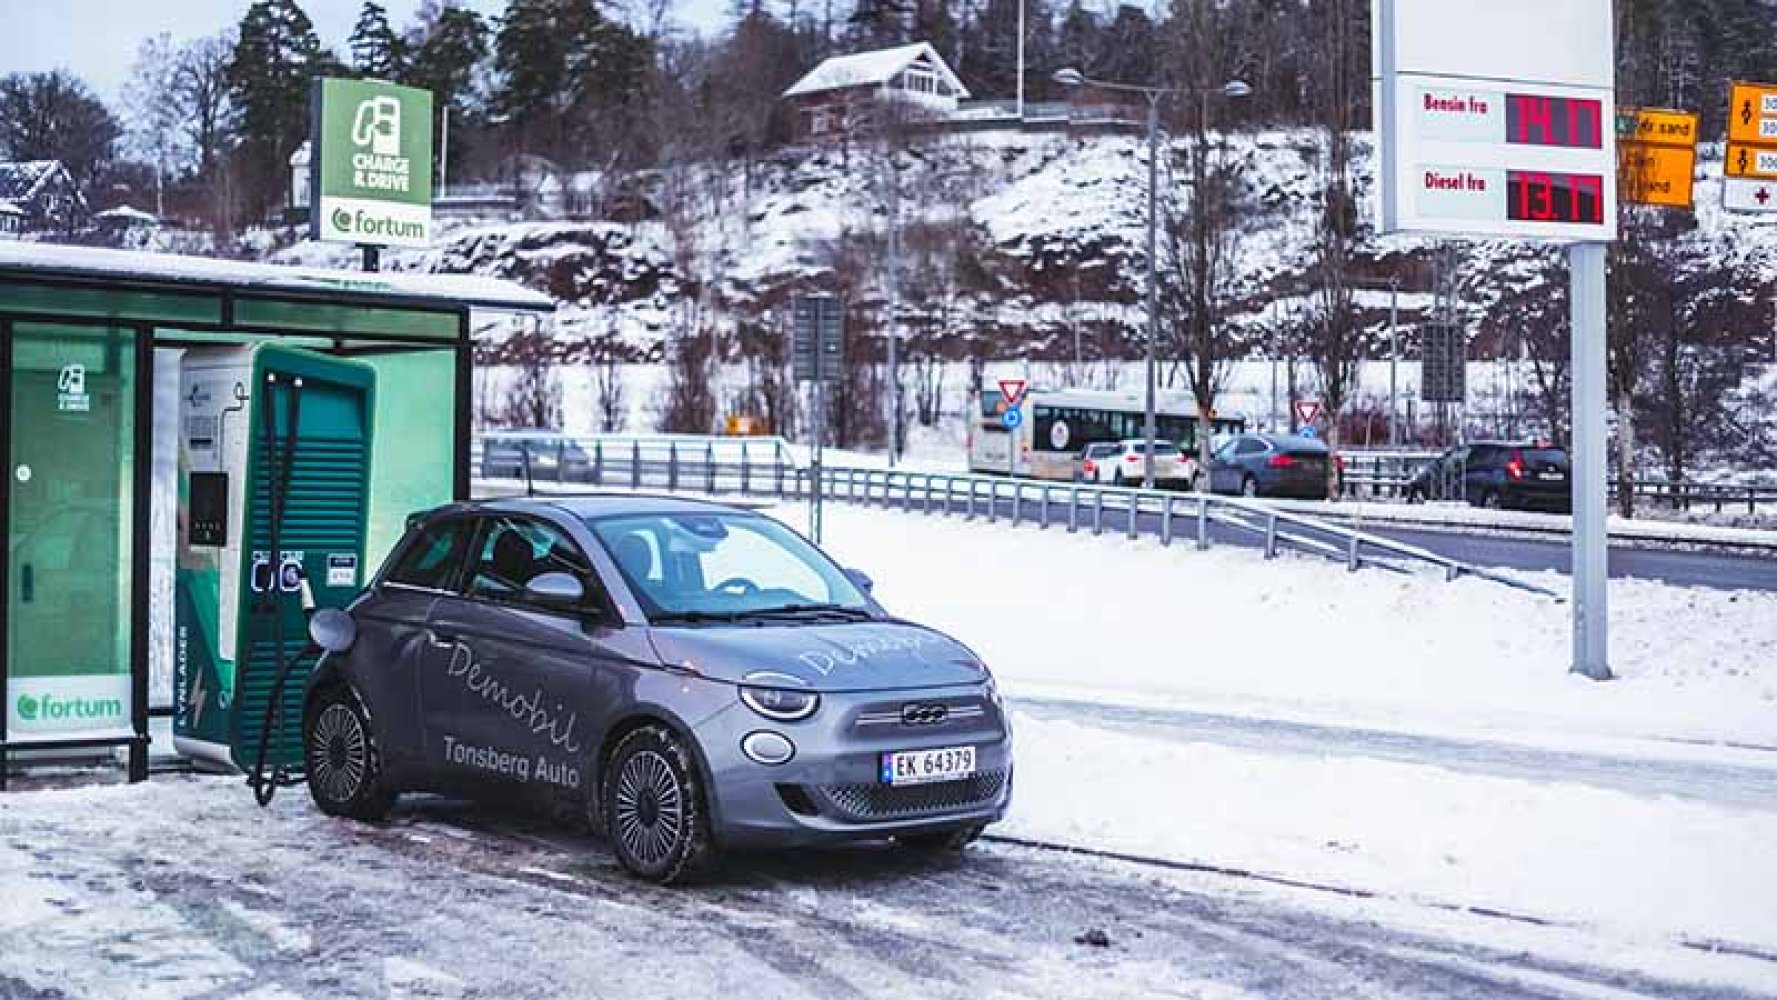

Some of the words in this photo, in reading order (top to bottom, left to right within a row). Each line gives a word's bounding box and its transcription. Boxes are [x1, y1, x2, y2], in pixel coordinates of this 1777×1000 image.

[1423, 93, 1466, 111] Bensin
[1469, 95, 1488, 114] fra
[353, 153, 409, 174] CHARGE
[368, 172, 409, 192] DRIVE
[1425, 171, 1464, 190] Diesel
[1468, 173, 1485, 191] fra
[355, 208, 424, 238] fortum
[41, 693, 121, 717] fortum
[448, 641, 581, 752] Demobil
[535, 755, 581, 789] Auto
[897, 755, 916, 776] EK
[923, 751, 972, 774] 64379
